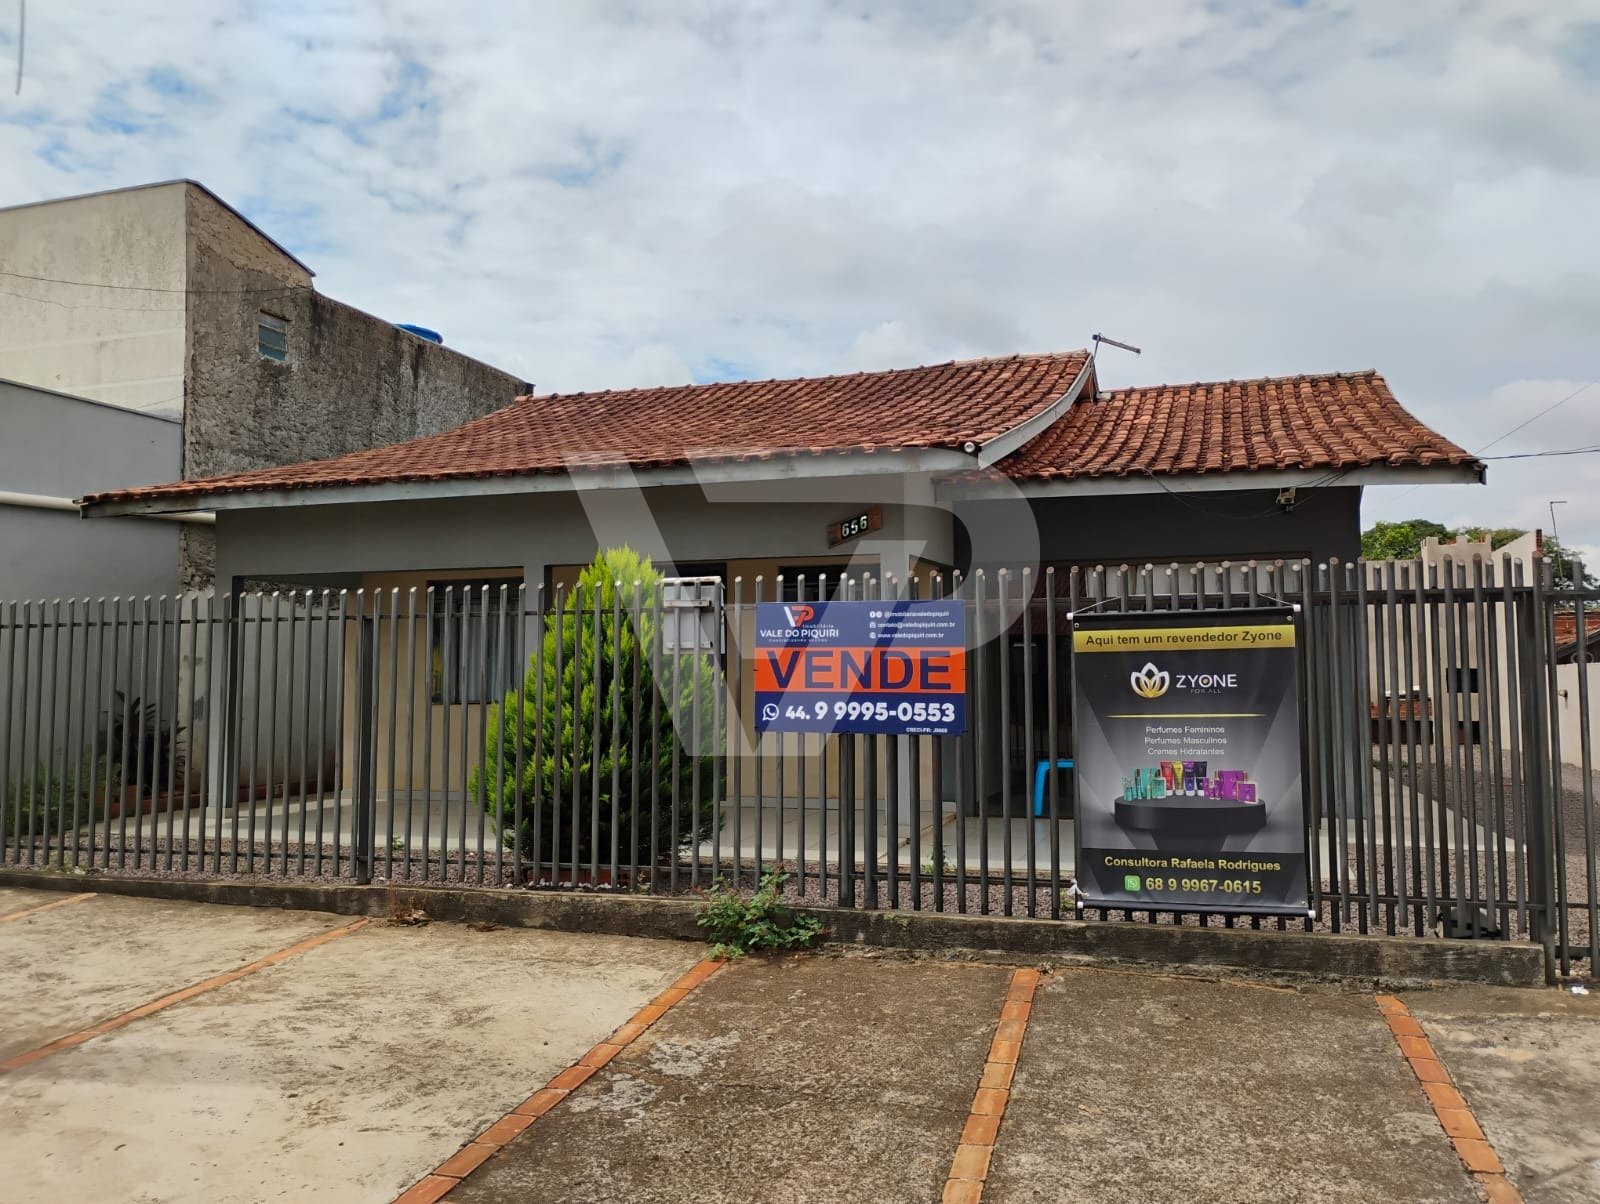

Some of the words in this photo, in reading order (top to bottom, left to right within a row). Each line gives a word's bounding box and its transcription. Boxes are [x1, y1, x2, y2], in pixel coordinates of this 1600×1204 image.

[842, 515, 867, 537] 656
[760, 629, 783, 638] VALE
[785, 629, 799, 638] DO
[801, 628, 839, 639] PIQUIRI
[1086, 635, 1114, 647] Aqui
[1117, 635, 1141, 645] tem
[1144, 635, 1163, 644] um
[1166, 632, 1239, 643] revendedor
[1242, 631, 1282, 643] Zyone
[767, 650, 952, 690] VENDE
[1176, 673, 1238, 688] ZYONE
[785, 705, 811, 720] 44.
[814, 701, 828, 720] 9
[834, 701, 956, 722] 9995-0553
[1145, 725, 1183, 734] Perfumes
[1144, 737, 1182, 745] Perfumes
[1104, 857, 1168, 868] Consultora
[1171, 858, 1215, 869] Rafaela
[1218, 859, 1281, 872] Rodrigues
[1145, 877, 1163, 890] 68
[1168, 878, 1177, 891] 9
[1181, 879, 1262, 893] 9967-0615
